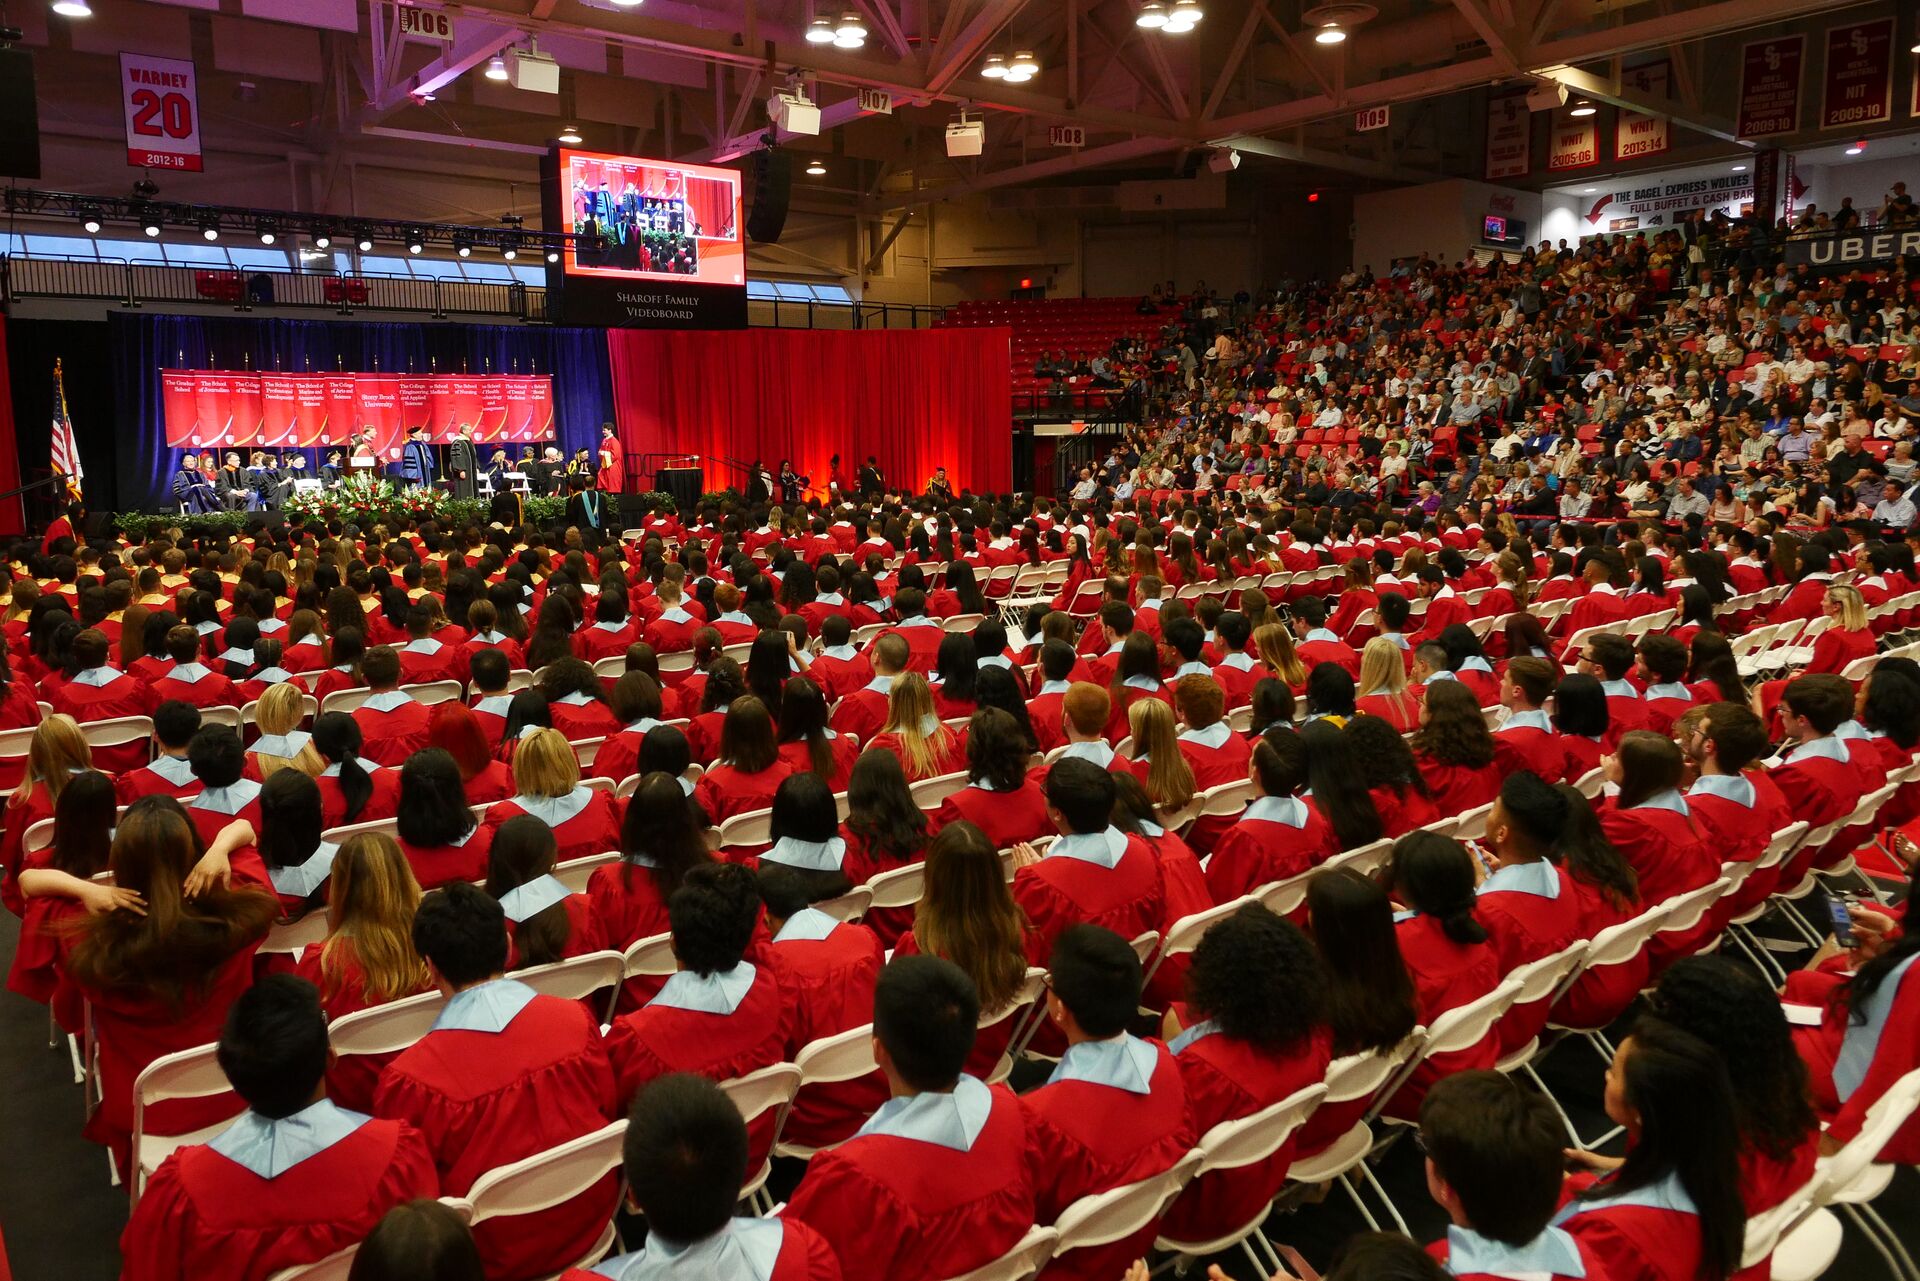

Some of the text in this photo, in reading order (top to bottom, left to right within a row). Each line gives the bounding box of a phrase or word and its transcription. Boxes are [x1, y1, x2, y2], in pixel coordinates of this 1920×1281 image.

[411, 11, 448, 36] 106
[129, 67, 187, 88] WARNEY
[865, 91, 888, 110] 107
[1845, 83, 1868, 100] NIT
[131, 88, 193, 139] 20
[1363, 110, 1386, 128] 109
[1829, 104, 1880, 124] 2009-10
[1630, 119, 1656, 135] WNIT
[1744, 117, 1790, 135] 2009-10
[1058, 129, 1082, 144] 108
[1561, 133, 1584, 147] WNIT
[1623, 136, 1662, 155] 2013-14
[147, 154, 185, 166] 2012-16
[1552, 150, 1591, 166] 2005-06
[1614, 174, 1749, 203] THE BAGEL EXPRESS WOLVES
[1630, 188, 1755, 214] FULL BUFFET & CASH BAR
[1810, 232, 1920, 264] UBER
[616, 292, 700, 307] SHAROFF FAMILY
[626, 306, 694, 320] VIDEOBOARD
